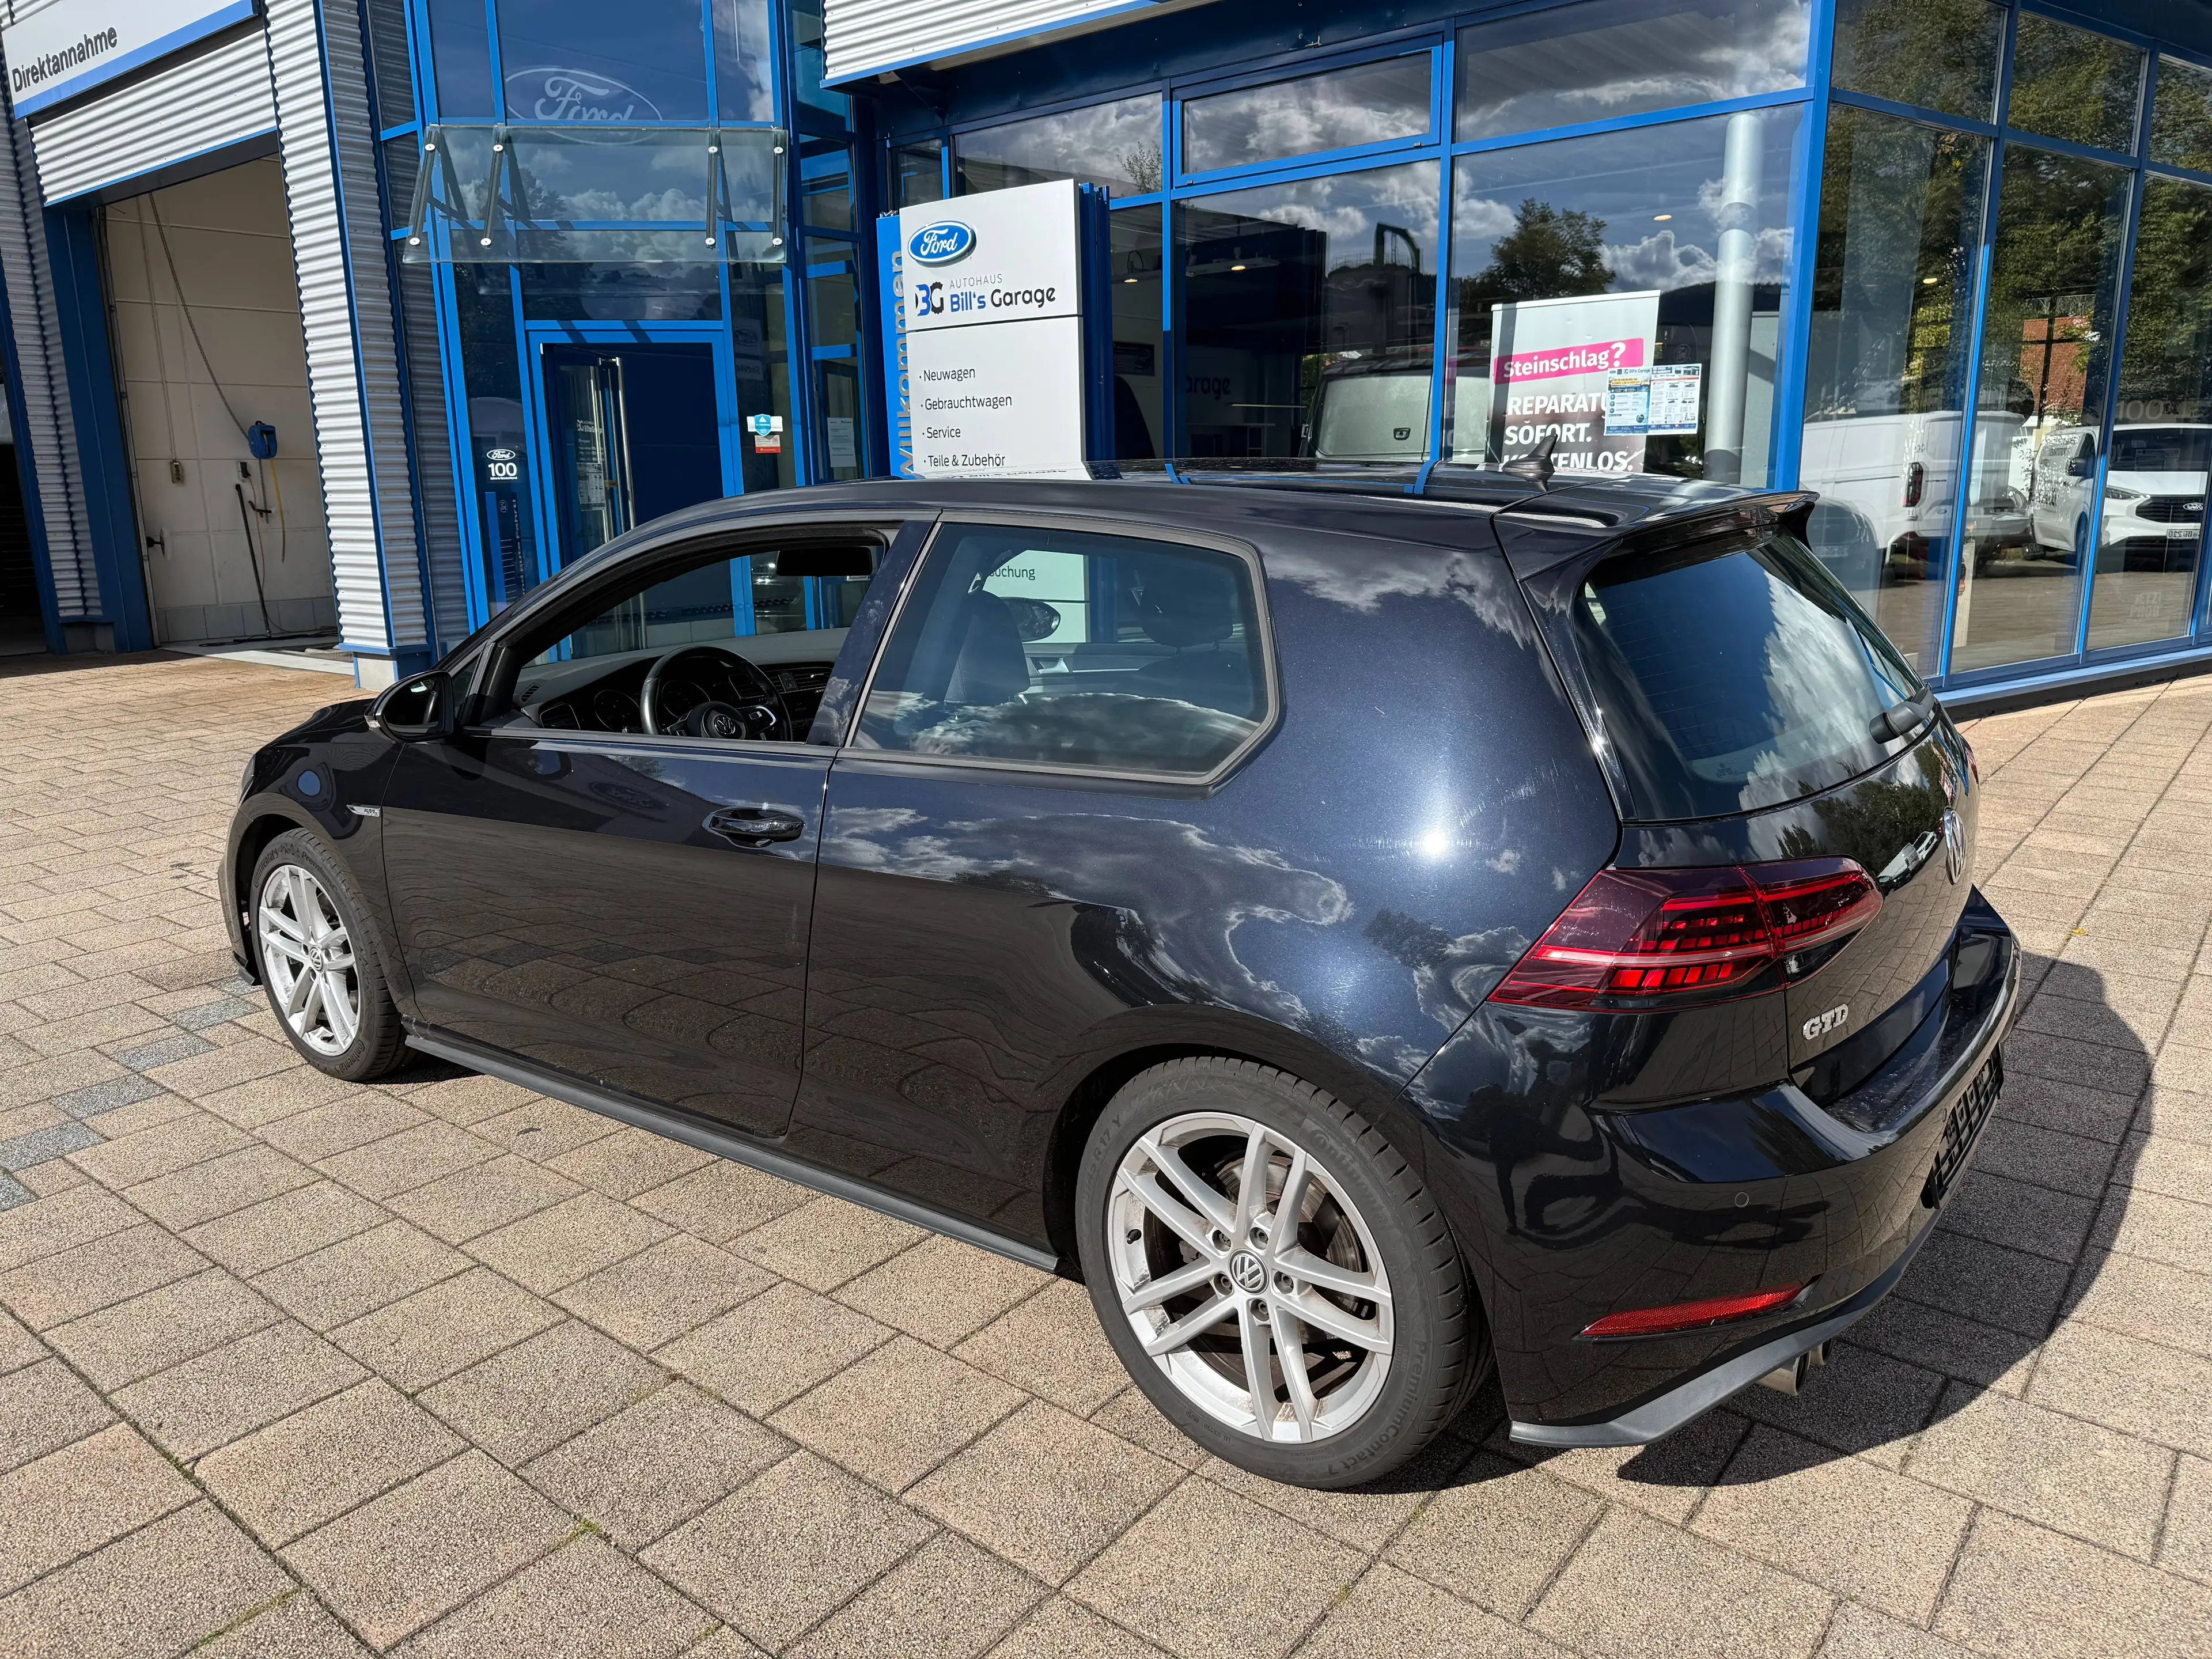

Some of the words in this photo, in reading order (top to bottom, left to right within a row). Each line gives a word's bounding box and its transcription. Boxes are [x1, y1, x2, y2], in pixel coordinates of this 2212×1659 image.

[12, 26, 118, 93] Direktannahme
[920, 228, 959, 256] Ford
[949, 274, 1003, 289] AUTOHAUS
[950, 290, 986, 312] Bill's
[990, 287, 1056, 308] Garage
[1503, 342, 1626, 378] Steinschlag?
[923, 368, 976, 381] Neuwagen
[925, 396, 1012, 410] Gebrauchtwagen
[926, 426, 961, 438] Service
[1504, 422, 1593, 445] SOFORT.
[927, 454, 949, 467] Teile
[952, 454, 960, 467] &
[961, 453, 1006, 467] Zubehör
[488, 463, 517, 477] 100
[1802, 1003, 1849, 1040] GTD
